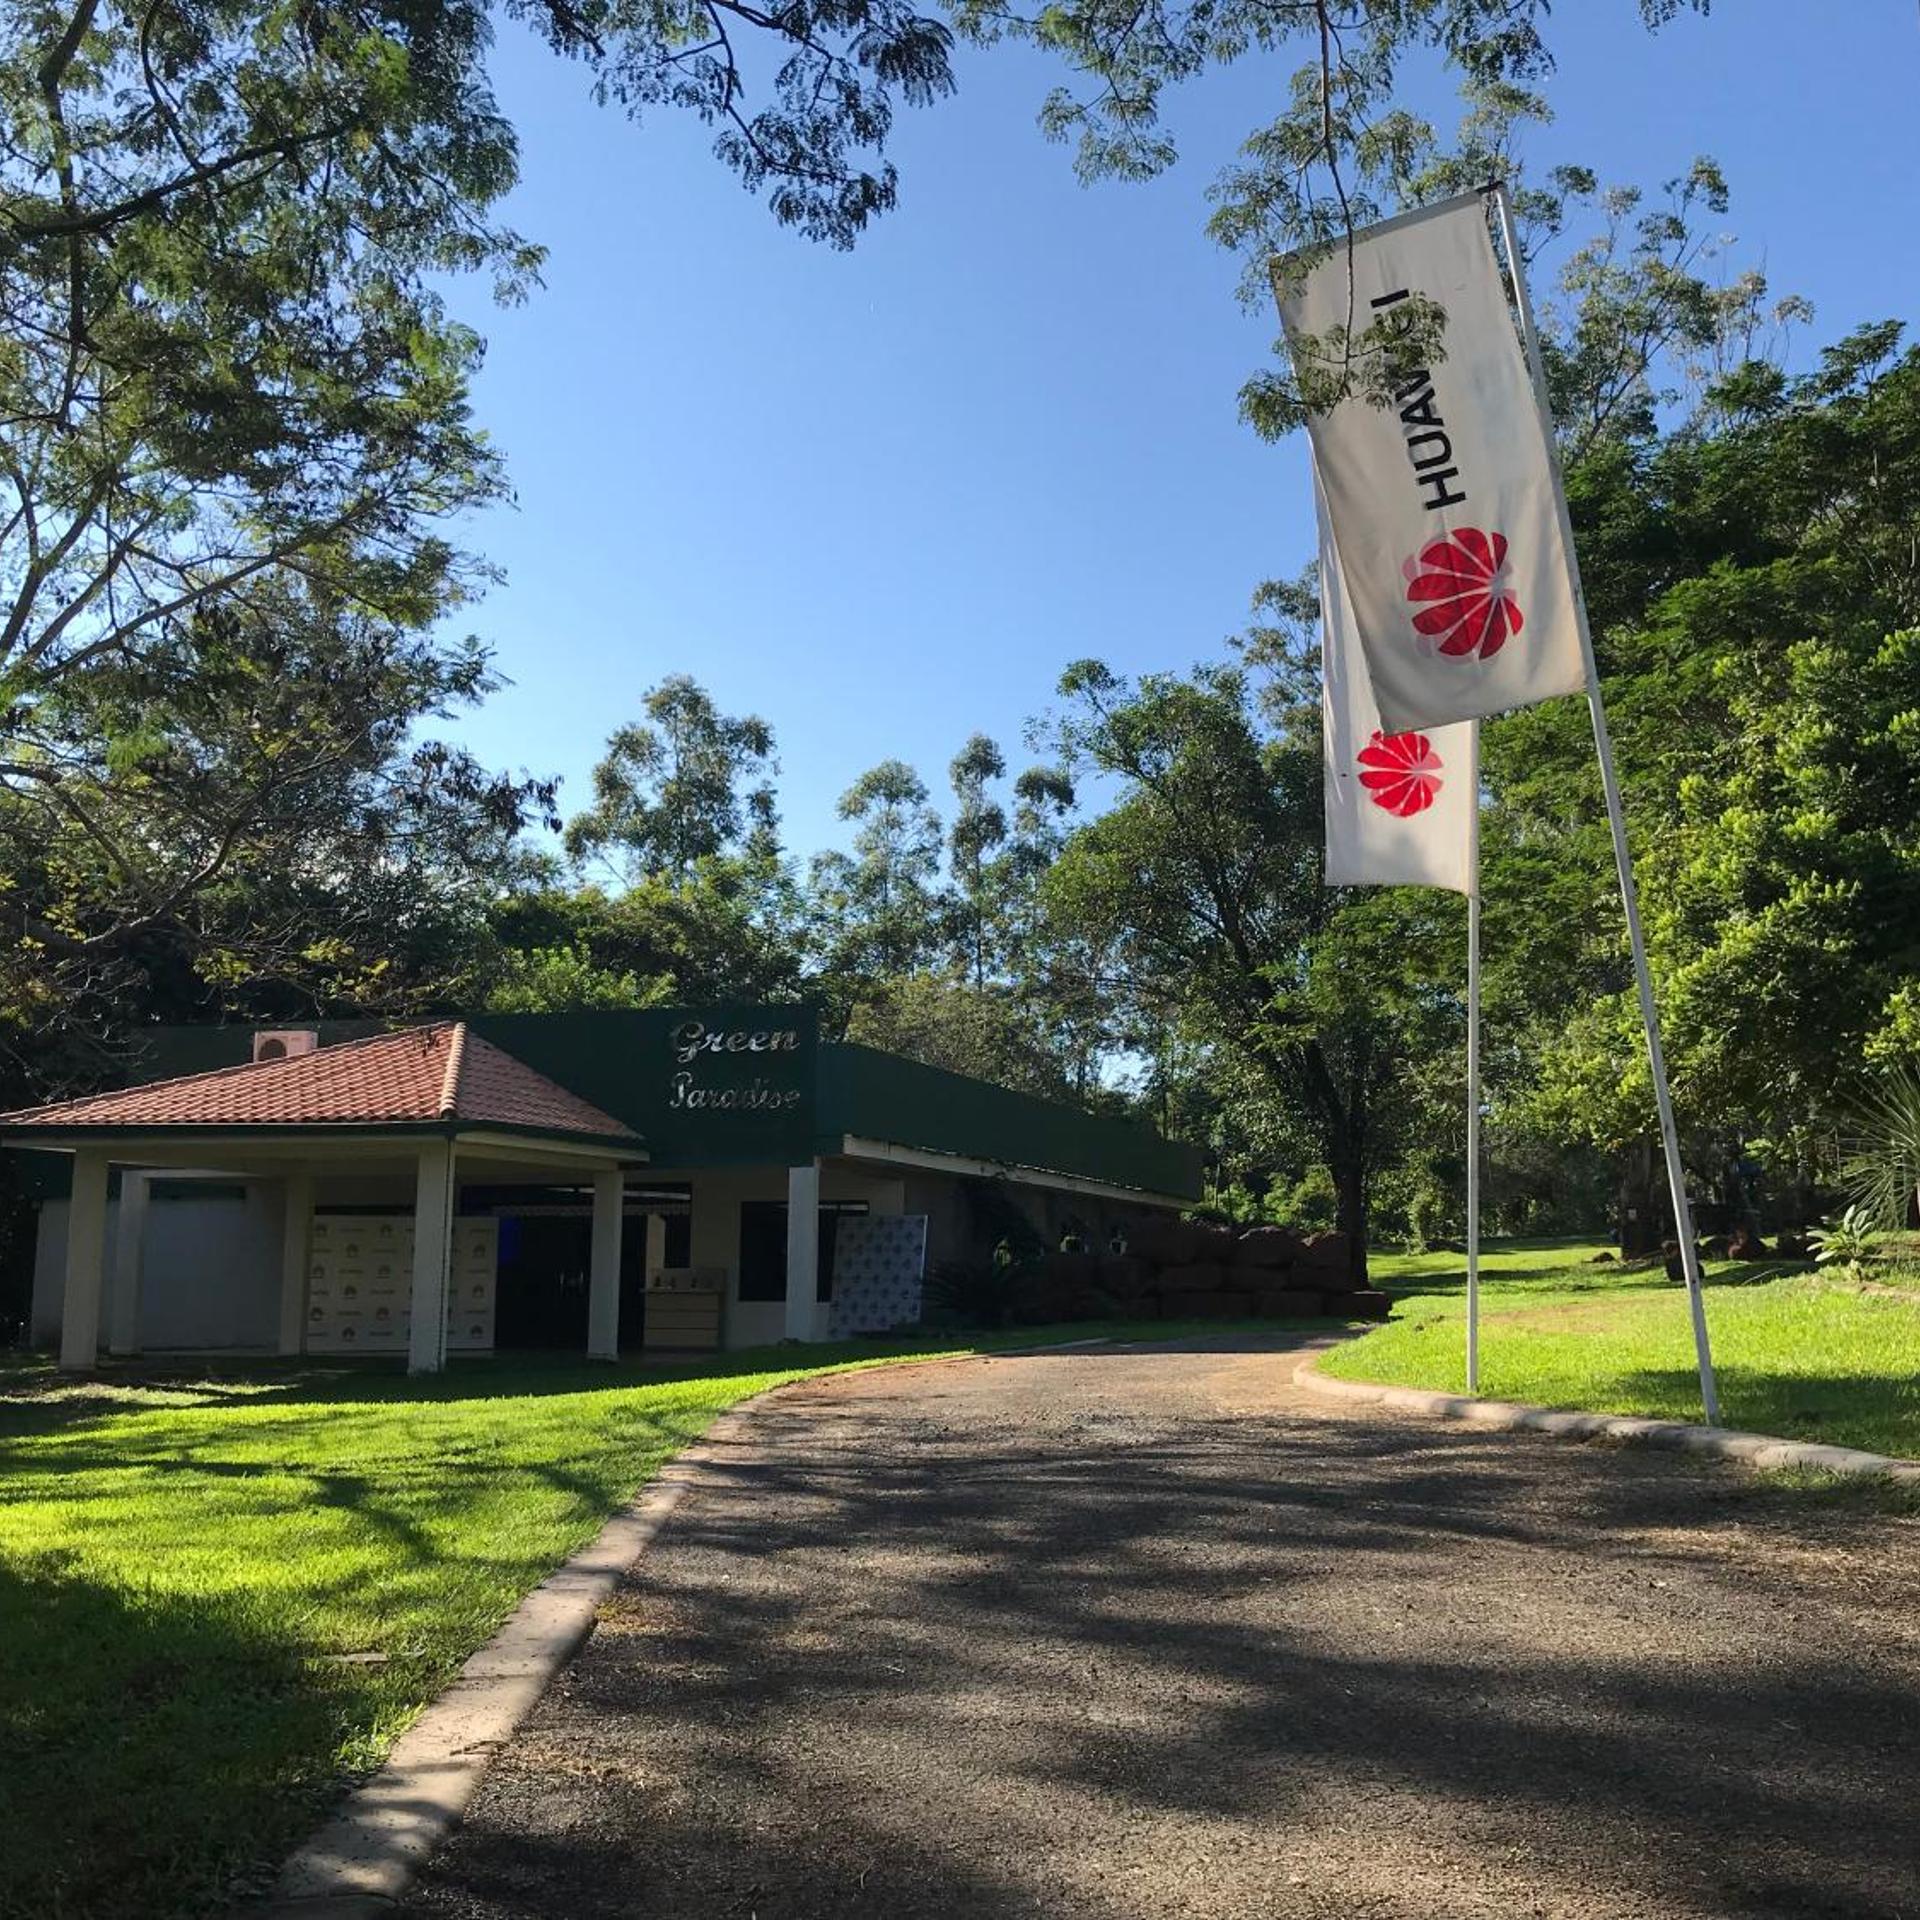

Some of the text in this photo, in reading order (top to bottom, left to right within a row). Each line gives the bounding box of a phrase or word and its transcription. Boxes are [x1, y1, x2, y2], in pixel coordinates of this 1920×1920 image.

[1370, 287, 1467, 512] HUAWI
[670, 1023, 801, 1063] Green
[669, 1071, 801, 1109] Paradise
